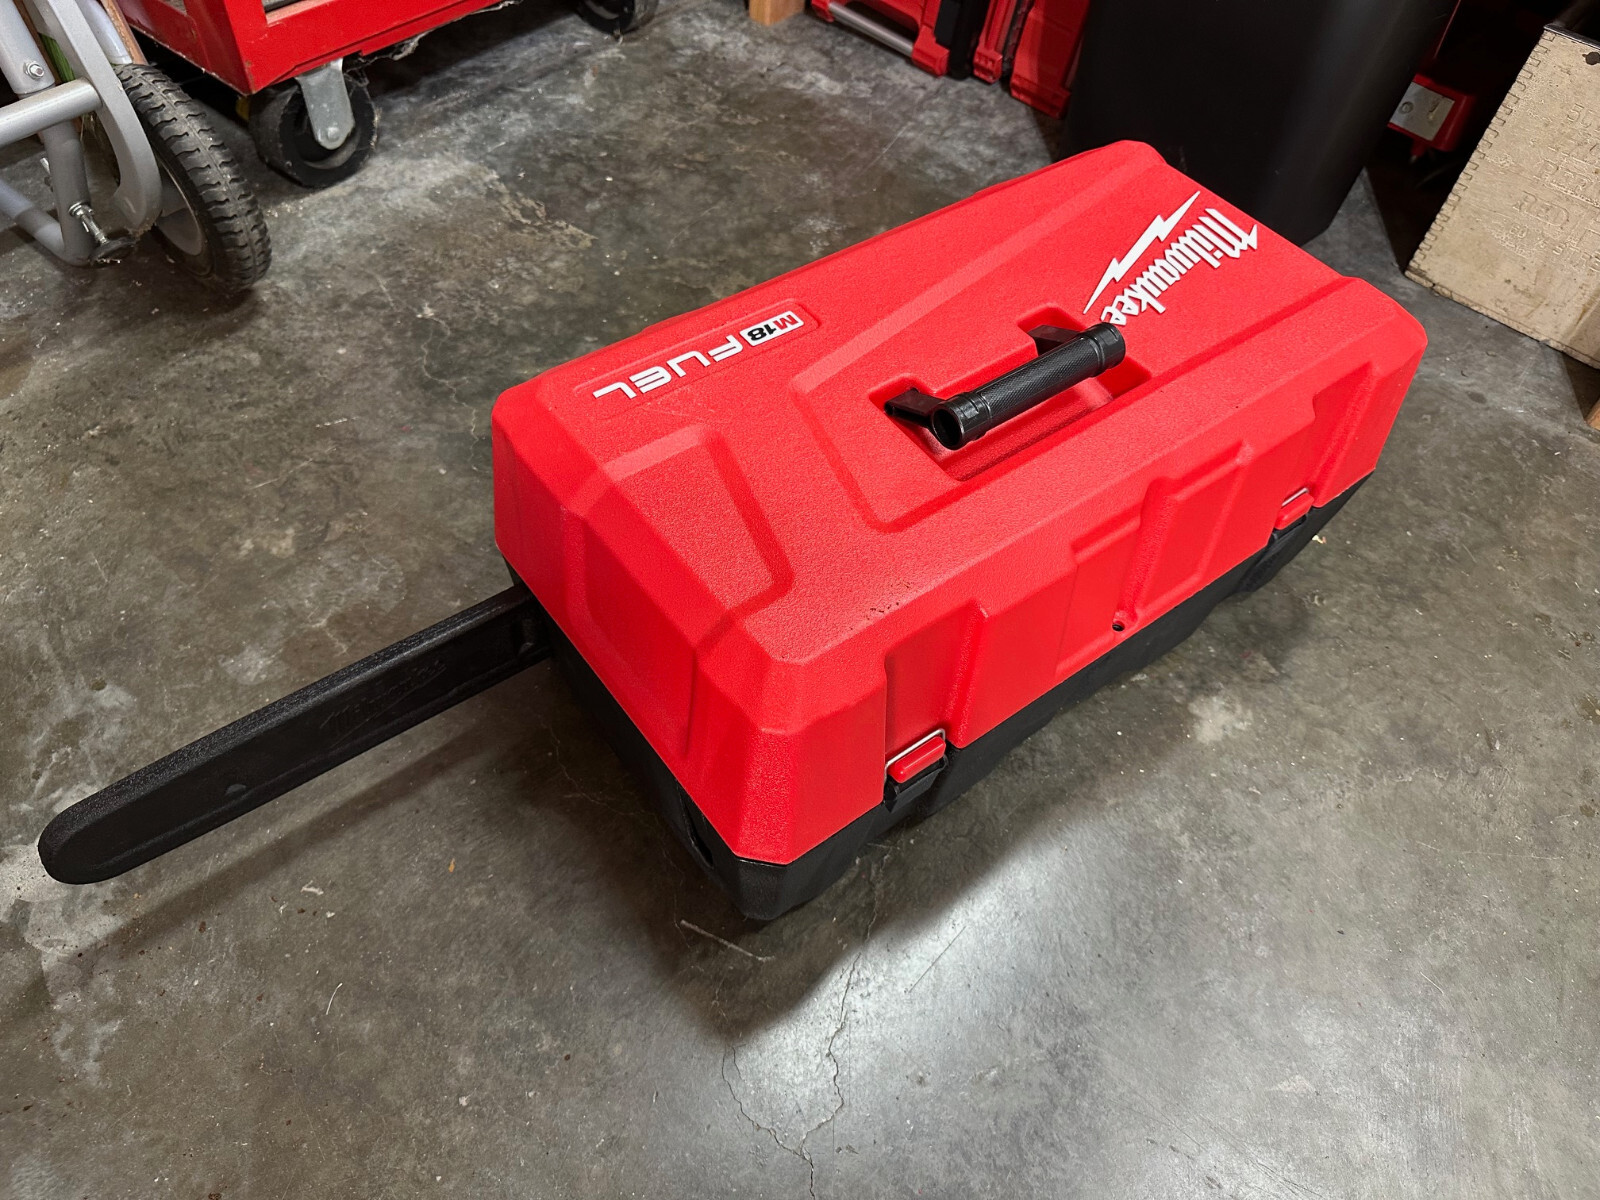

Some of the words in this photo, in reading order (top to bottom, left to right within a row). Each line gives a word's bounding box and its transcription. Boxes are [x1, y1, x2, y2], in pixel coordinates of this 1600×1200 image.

[1101, 208, 1258, 326] Milwaukee
[747, 314, 798, 341] M18
[592, 334, 743, 400] FUEL
